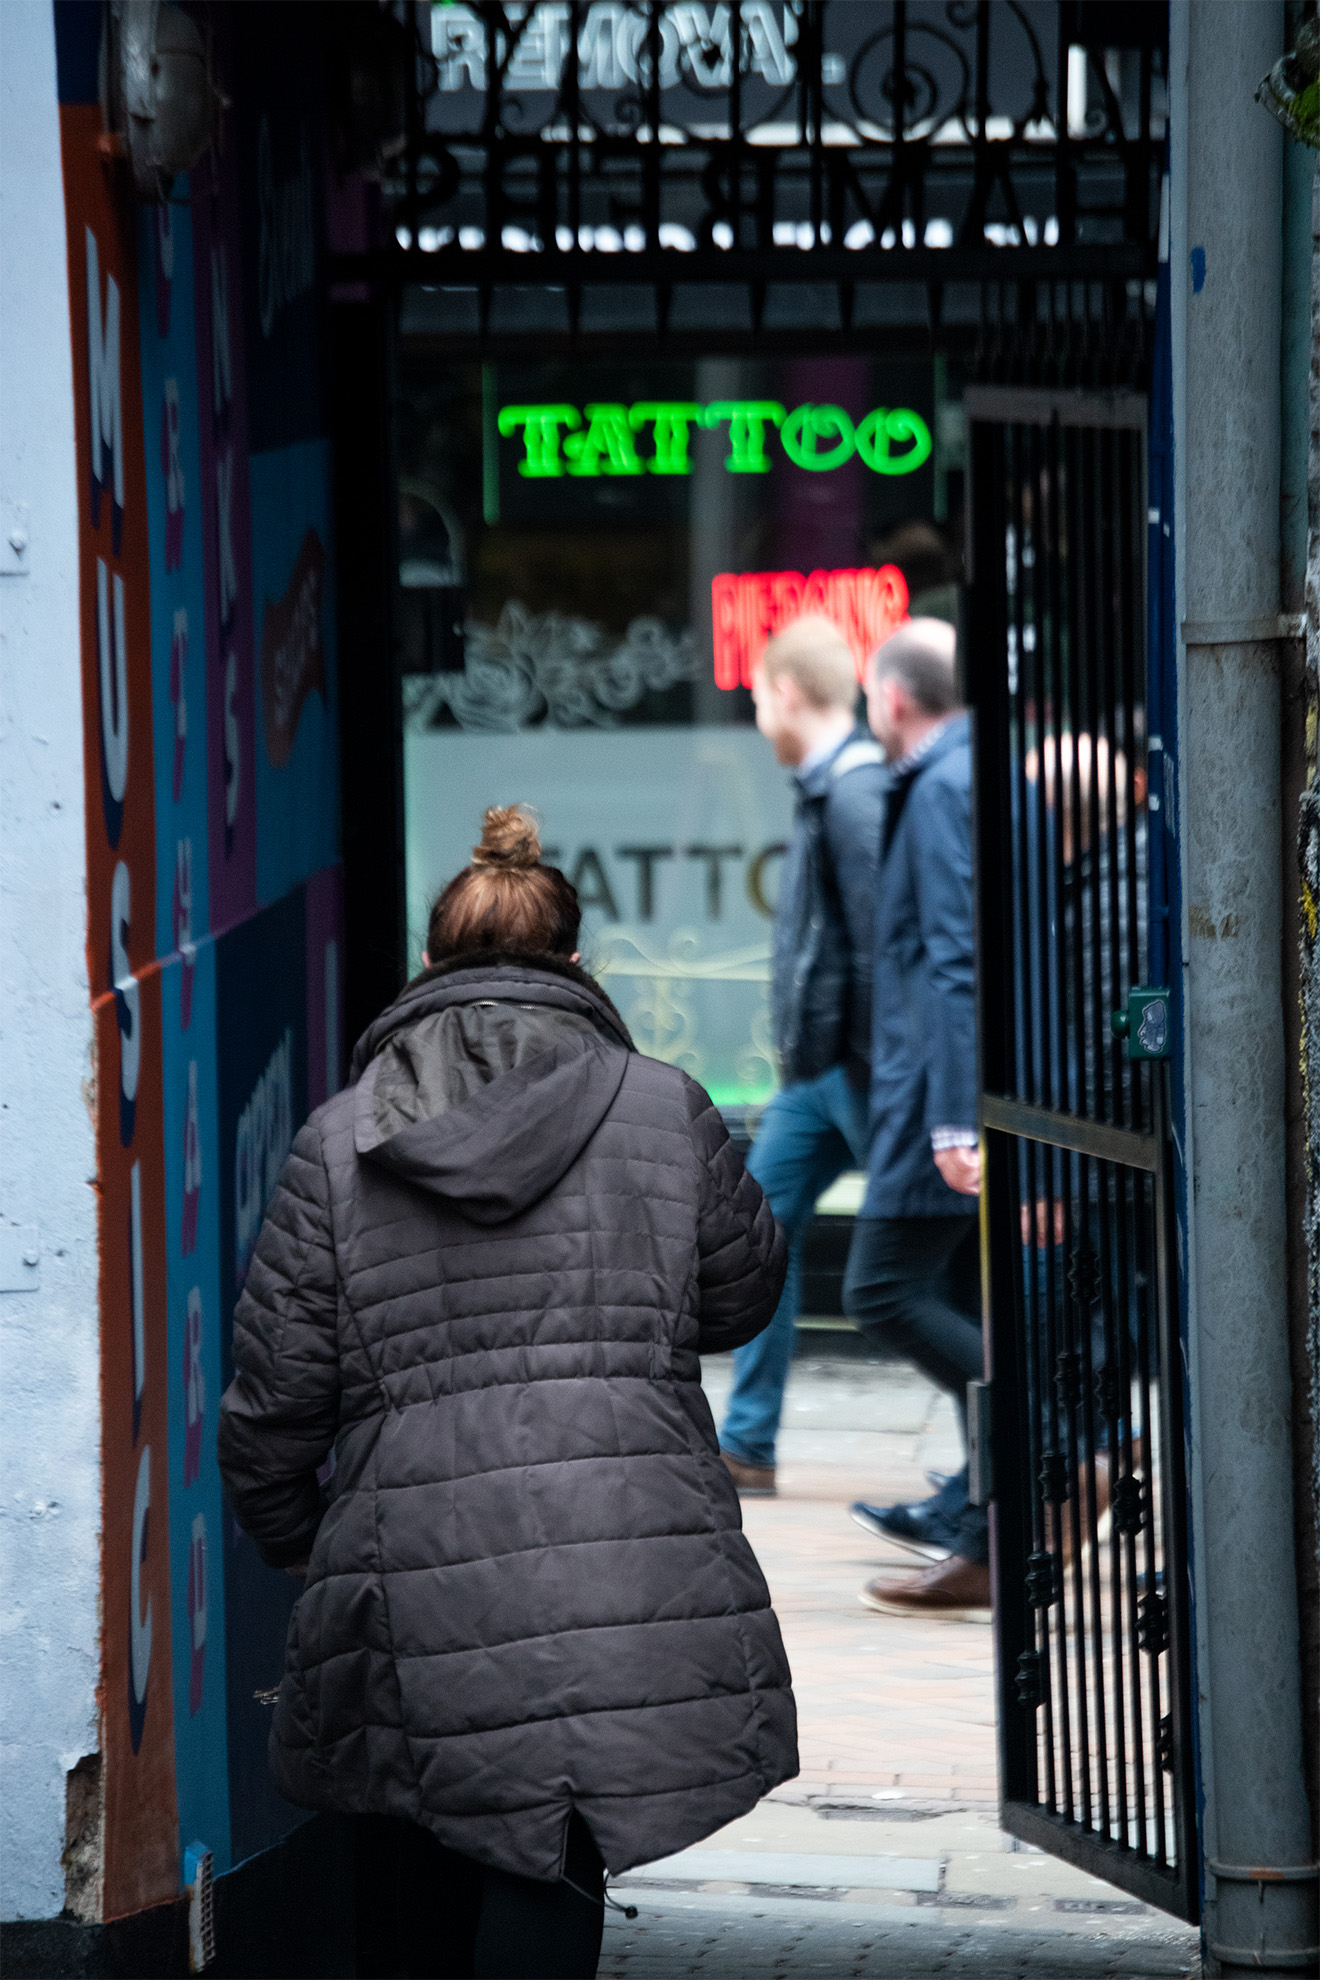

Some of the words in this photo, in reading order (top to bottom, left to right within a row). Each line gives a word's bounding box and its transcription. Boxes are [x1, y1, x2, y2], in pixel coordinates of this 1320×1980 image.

[430, 2, 846, 91] REMOVA
[498, 400, 933, 478] TATTOO
[86, 225, 153, 1705] MUSIC
